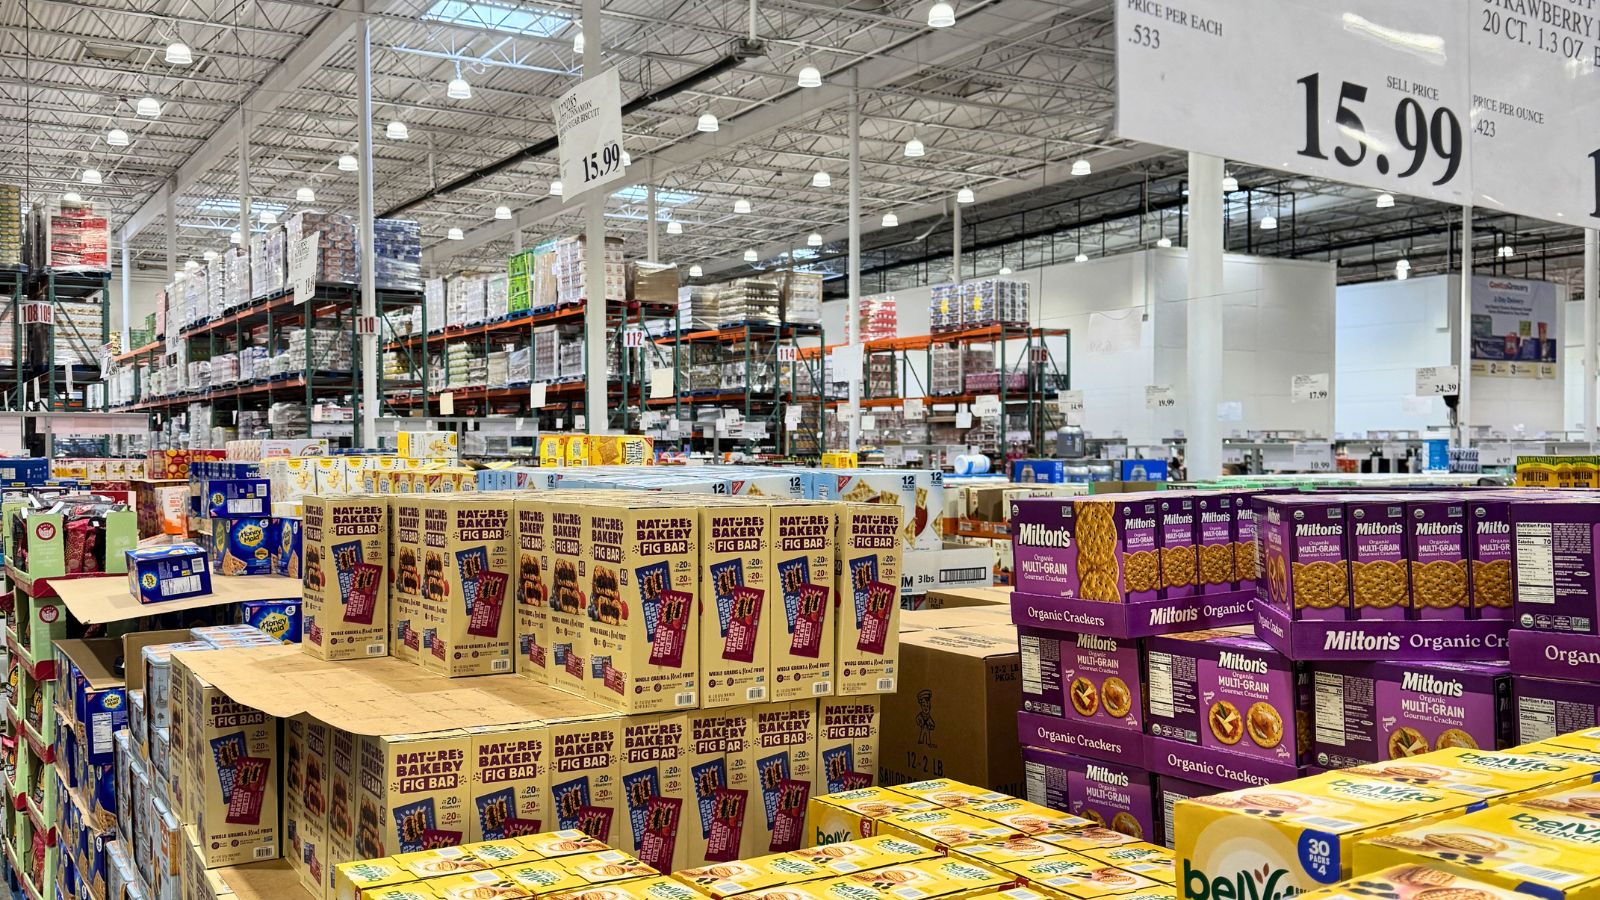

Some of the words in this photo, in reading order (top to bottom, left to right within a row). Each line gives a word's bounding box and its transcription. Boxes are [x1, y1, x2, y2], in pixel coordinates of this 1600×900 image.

[1127, 0, 1162, 18] PRICE
[1165, 8, 1187, 26] PER
[1190, 12, 1223, 36] EACH
[1482, 0, 1593, 37] AWBERRY
[1128, 24, 1161, 50] .533
[1482, 9, 1500, 35] 20
[1506, 17, 1531, 45] CT.
[1539, 28, 1558, 53] 1.3
[1387, 75, 1410, 94] SELL
[1412, 81, 1439, 100] PRICE
[1472, 95, 1496, 113] PRICE
[1498, 101, 1514, 117] PER
[1516, 105, 1545, 125] OUNCE
[1296, 72, 1462, 186] 15.99
[1473, 119, 1496, 138] .423
[582, 143, 620, 182] 15.99
[22, 305, 39, 322] 108
[358, 317, 374, 334] 110
[626, 332, 643, 346] 112
[779, 348, 795, 361] 114
[1309, 391, 1327, 399] 17.99
[1435, 384, 1457, 394] 24.39
[1310, 462, 1330, 470] 10.99
[548, 475, 554, 483] 12
[789, 477, 800, 486] 12
[902, 476, 914, 485] 12
[930, 472, 942, 481] 12
[1523, 472, 1549, 481] PROTEIN
[712, 483, 725, 494] 12
[333, 516, 382, 524] BAKERY
[457, 519, 508, 528] BAKERY
[1125, 518, 1155, 530] Milton's
[1163, 514, 1192, 525] Milton's
[1201, 512, 1230, 523] Milton's
[240, 528, 261, 539] Honey
[339, 526, 354, 535] FIG
[358, 525, 377, 534] BAR
[463, 531, 479, 540] FIG
[483, 529, 502, 538] BAR
[637, 529, 692, 540] BAKERY
[712, 527, 764, 537] BAKERY
[779, 525, 828, 536] BAKERY
[852, 524, 898, 535] BAKERY
[1296, 523, 1343, 537] Milton's
[1355, 522, 1403, 536] Milton's
[1416, 522, 1463, 535] Milton's
[244, 535, 260, 544] Maid
[857, 537, 872, 547] FIG
[875, 537, 892, 547] BAR
[1019, 523, 1071, 548] Milton's
[643, 543, 661, 553] FIG
[665, 541, 686, 552] BAR
[718, 540, 734, 551] FIG
[738, 539, 758, 550] BAR
[785, 539, 800, 549] FIG
[804, 537, 823, 548] BAR
[1299, 545, 1340, 553] MULTI-GRAIN
[1359, 544, 1400, 552] MULTI-GRAIN
[1419, 544, 1460, 552] MULTI-GRAIN
[1034, 554, 1053, 562] Organic
[1022, 561, 1068, 575] MULTI-GRAIN
[1024, 573, 1044, 581] Gourmet
[1046, 574, 1067, 583] Crackers
[1028, 607, 1062, 622] Organic
[1064, 611, 1105, 626] Crackers
[1150, 606, 1198, 626] Milton's
[1204, 602, 1244, 617] Organic
[261, 618, 287, 630] Honey
[266, 625, 284, 635] Maid
[1077, 633, 1117, 652] Milton's
[1324, 631, 1400, 651] Milton's
[1410, 634, 1480, 650] Organic
[1545, 645, 1600, 665] Organ
[1010, 664, 1018, 672] LB
[1077, 656, 1119, 669] MULTI-GRAIN
[1218, 651, 1268, 675] Milton's
[1218, 677, 1270, 693] MULTI-GRAIN
[1401, 671, 1463, 697] Milton's
[1419, 694, 1445, 704] Organic
[1401, 699, 1464, 718] MULTI-GRAIN
[218, 717, 236, 727] FIG
[240, 715, 263, 725] BAR
[825, 713, 874, 725] BAKERY
[1404, 712, 1432, 722] Gourmet
[1433, 715, 1463, 727] Crackers
[693, 727, 747, 739] BAKERY
[759, 720, 810, 733] BAKERY
[830, 727, 846, 738] FIG
[849, 725, 868, 737] BAR
[625, 735, 682, 748] BAKERY
[764, 734, 780, 746] FIG
[784, 732, 804, 743] BAR
[1037, 727, 1076, 745] Organic
[1077, 735, 1121, 754] Crackers
[555, 741, 614, 757] BAKERY
[699, 741, 716, 753] FIG
[719, 740, 741, 752] BAR
[479, 751, 541, 767] BAKERY
[631, 750, 649, 762] FIG
[652, 748, 676, 759] BAR
[397, 760, 463, 777] BAKERY
[561, 758, 579, 770] FIG
[584, 755, 606, 767] BAR
[1455, 752, 1570, 772] belVita
[1462, 760, 1535, 773] CRUNCHY
[485, 769, 505, 782] FIG
[510, 766, 534, 778] BAR
[1168, 753, 1213, 775] Organic
[1216, 765, 1270, 785] Crackers
[1086, 765, 1129, 787] Milton's
[403, 779, 424, 791] FIG
[429, 776, 456, 789] BAR
[1086, 787, 1131, 804] MULTI-GRAIN
[1327, 779, 1445, 803] belVita
[1334, 787, 1410, 803] CRUNCHY
[1518, 824, 1600, 843] CRUNCH
[1308, 838, 1329, 856] 30
[1309, 855, 1330, 865] PACKS
[1318, 866, 1327, 876] 4
